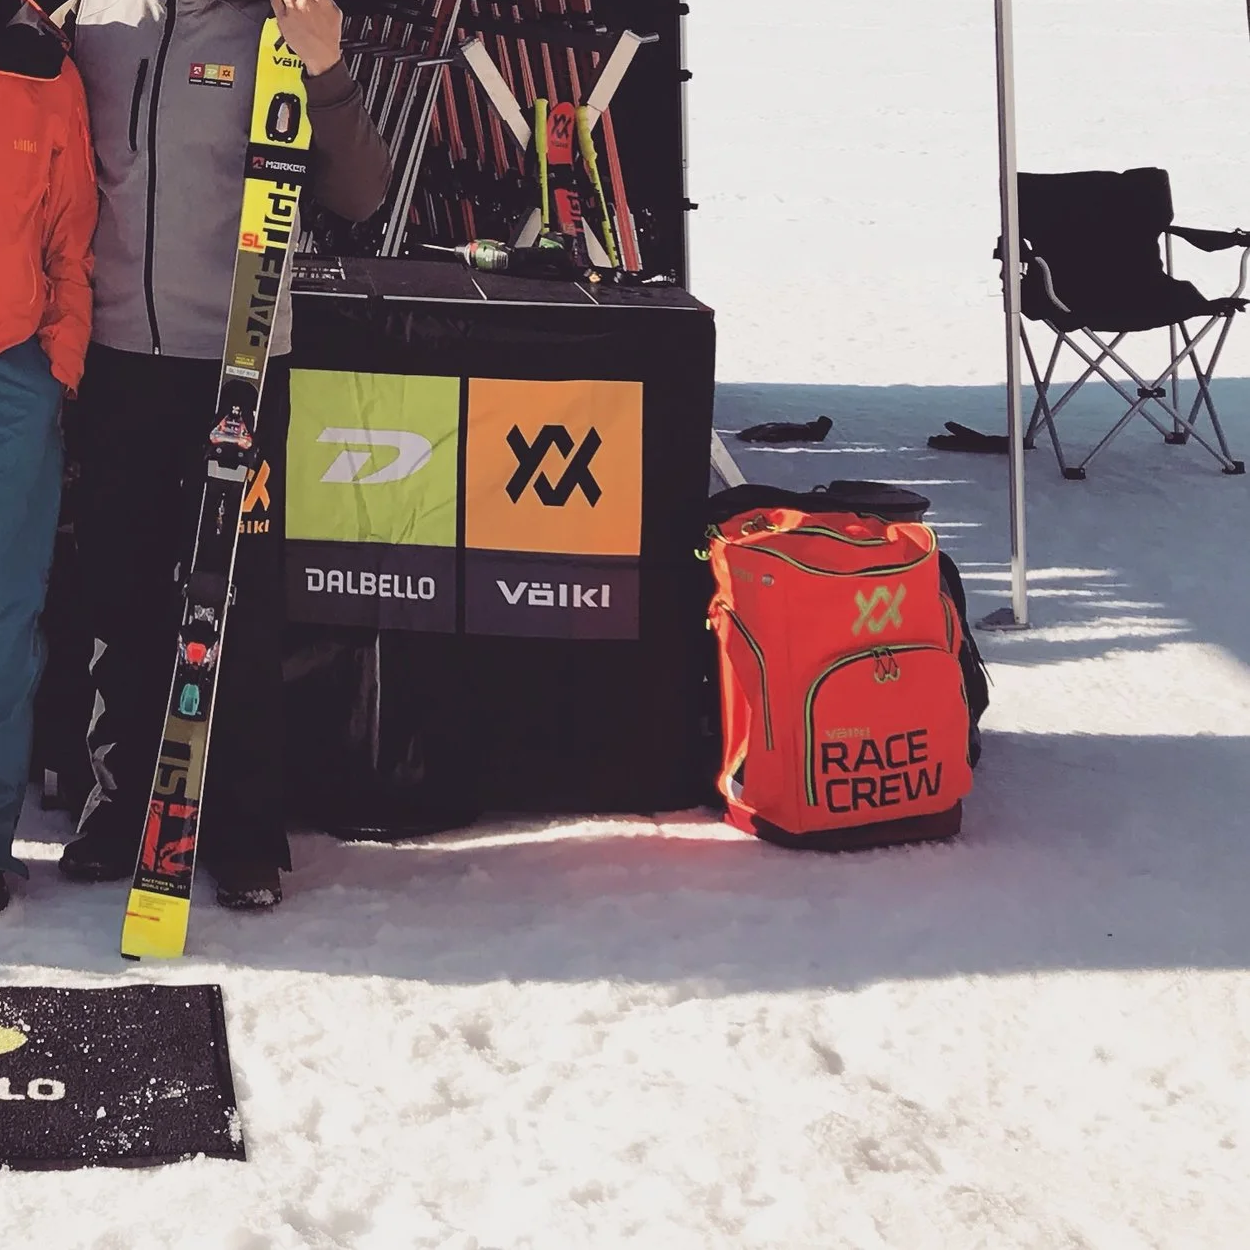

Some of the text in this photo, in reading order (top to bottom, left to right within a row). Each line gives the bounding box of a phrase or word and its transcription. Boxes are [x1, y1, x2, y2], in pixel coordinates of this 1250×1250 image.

[273, 56, 306, 68] Völk
[242, 233, 264, 249] SL
[305, 567, 436, 601] DALBELLO
[821, 728, 928, 775] RACE
[826, 761, 943, 814] CREW
